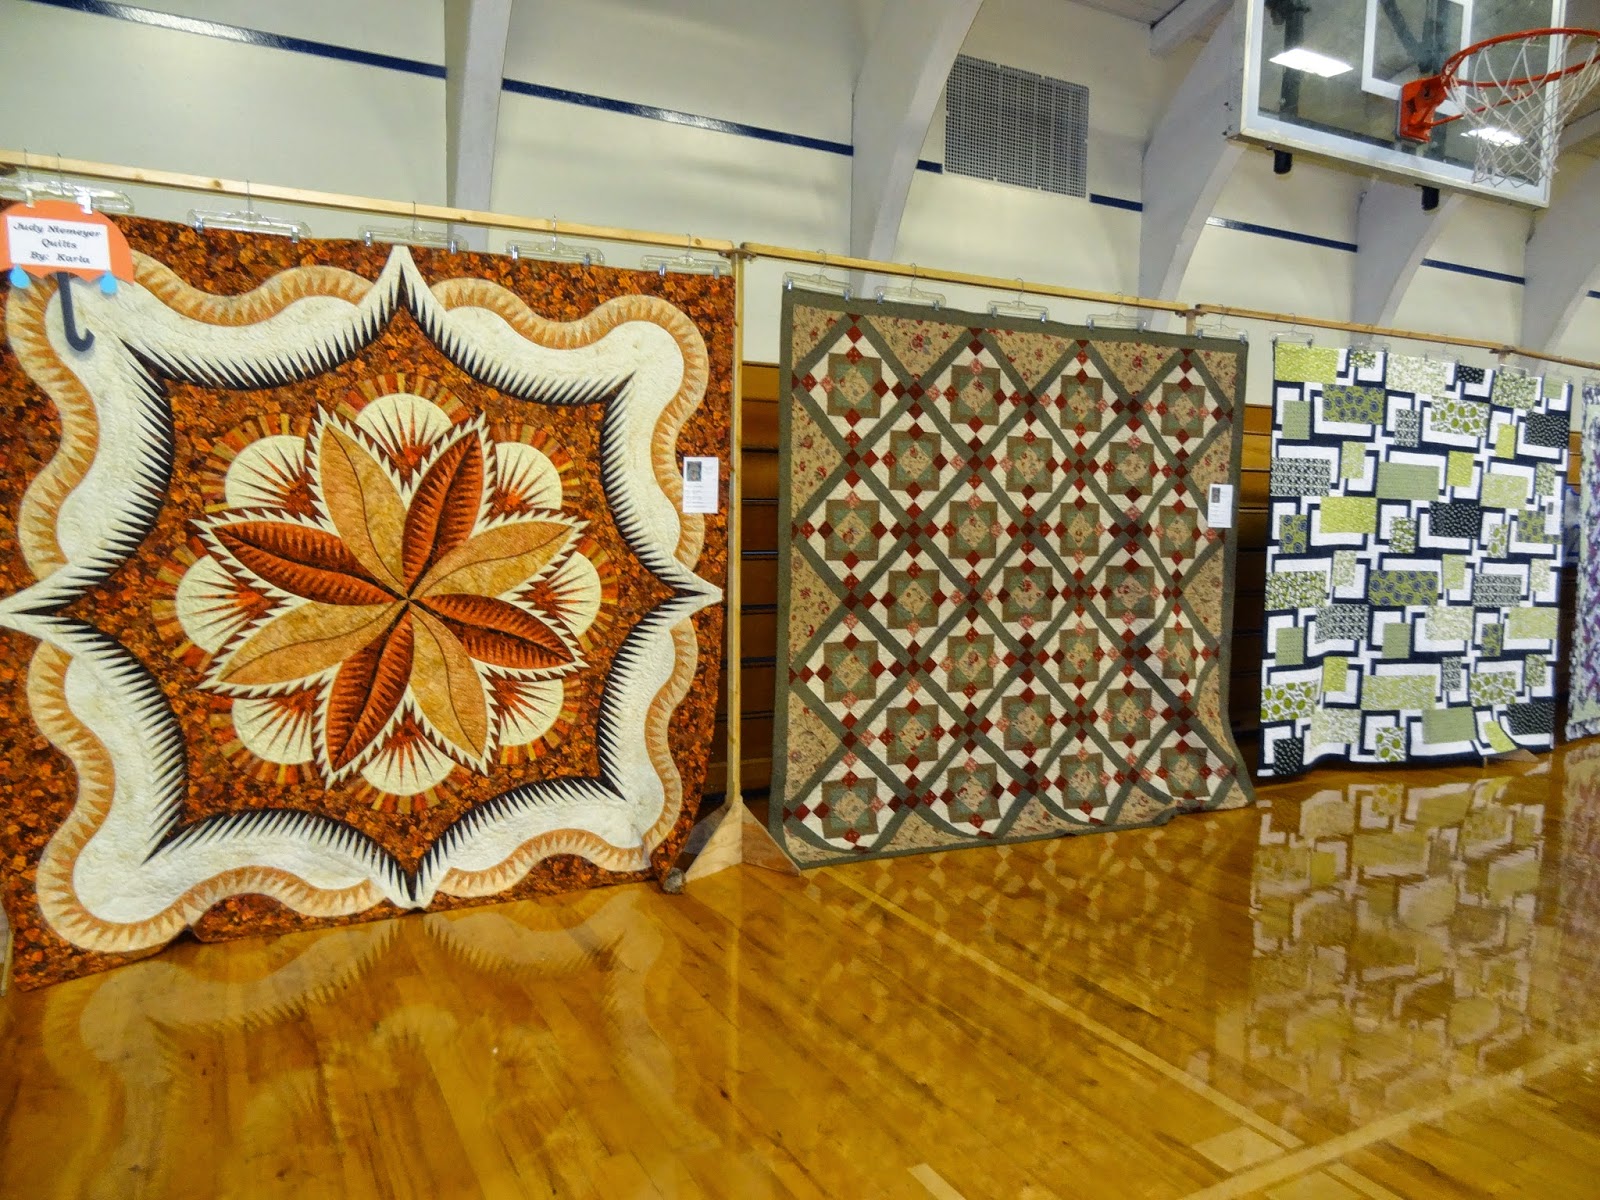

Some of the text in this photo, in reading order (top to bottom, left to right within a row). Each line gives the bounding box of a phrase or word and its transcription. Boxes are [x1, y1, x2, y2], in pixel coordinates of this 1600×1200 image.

[13, 222, 101, 238] Judy Niemeyer
[41, 238, 77, 249] Quilts
[30, 251, 90, 264] By: Karla
